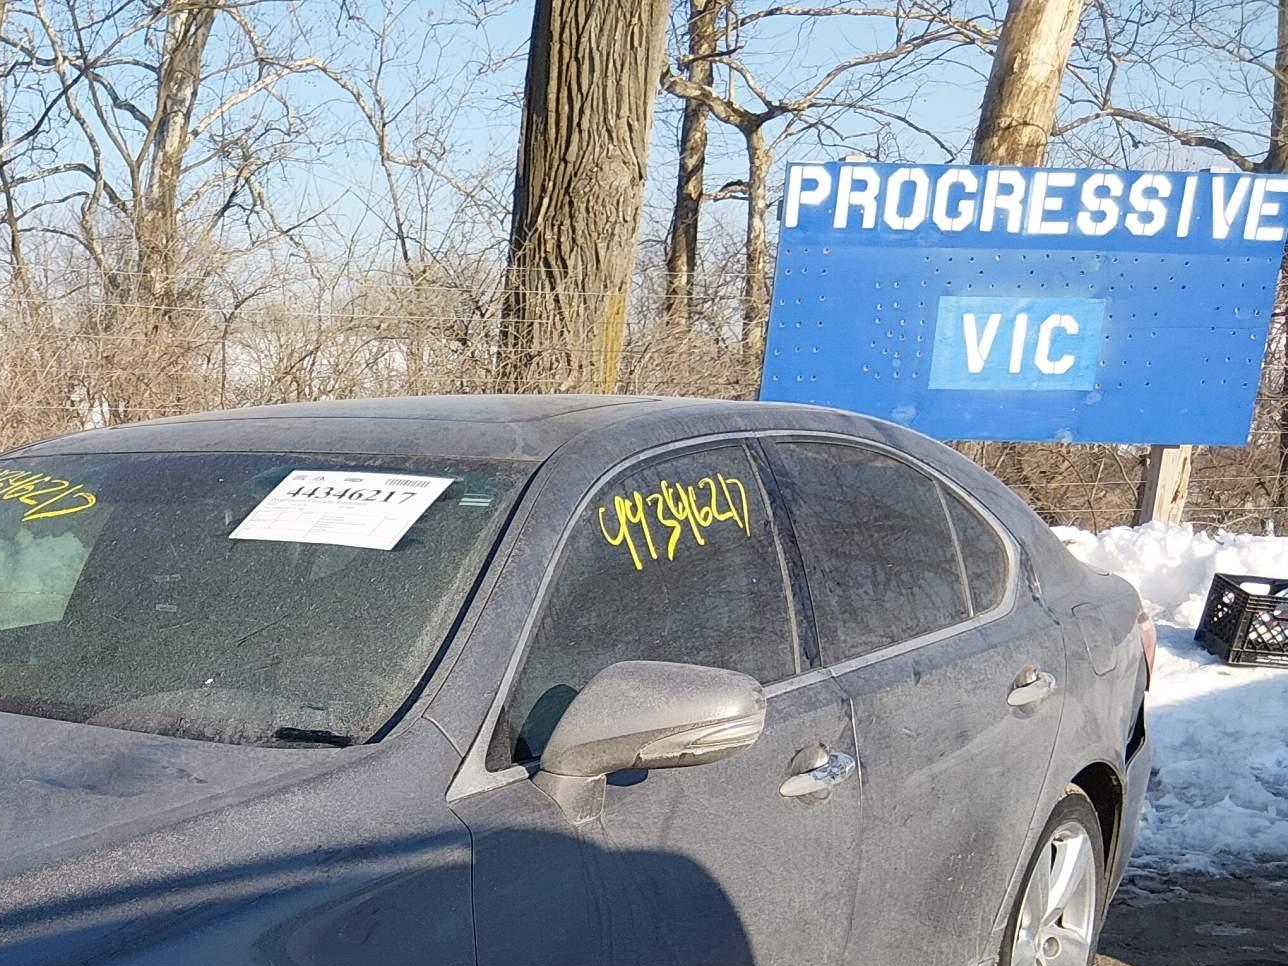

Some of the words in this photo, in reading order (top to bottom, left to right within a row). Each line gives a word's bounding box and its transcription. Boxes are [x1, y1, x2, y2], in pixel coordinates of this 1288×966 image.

[785, 165, 1288, 241] PROGRESSIVE
[962, 313, 1080, 375] VIC
[286, 485, 418, 505] 44346217
